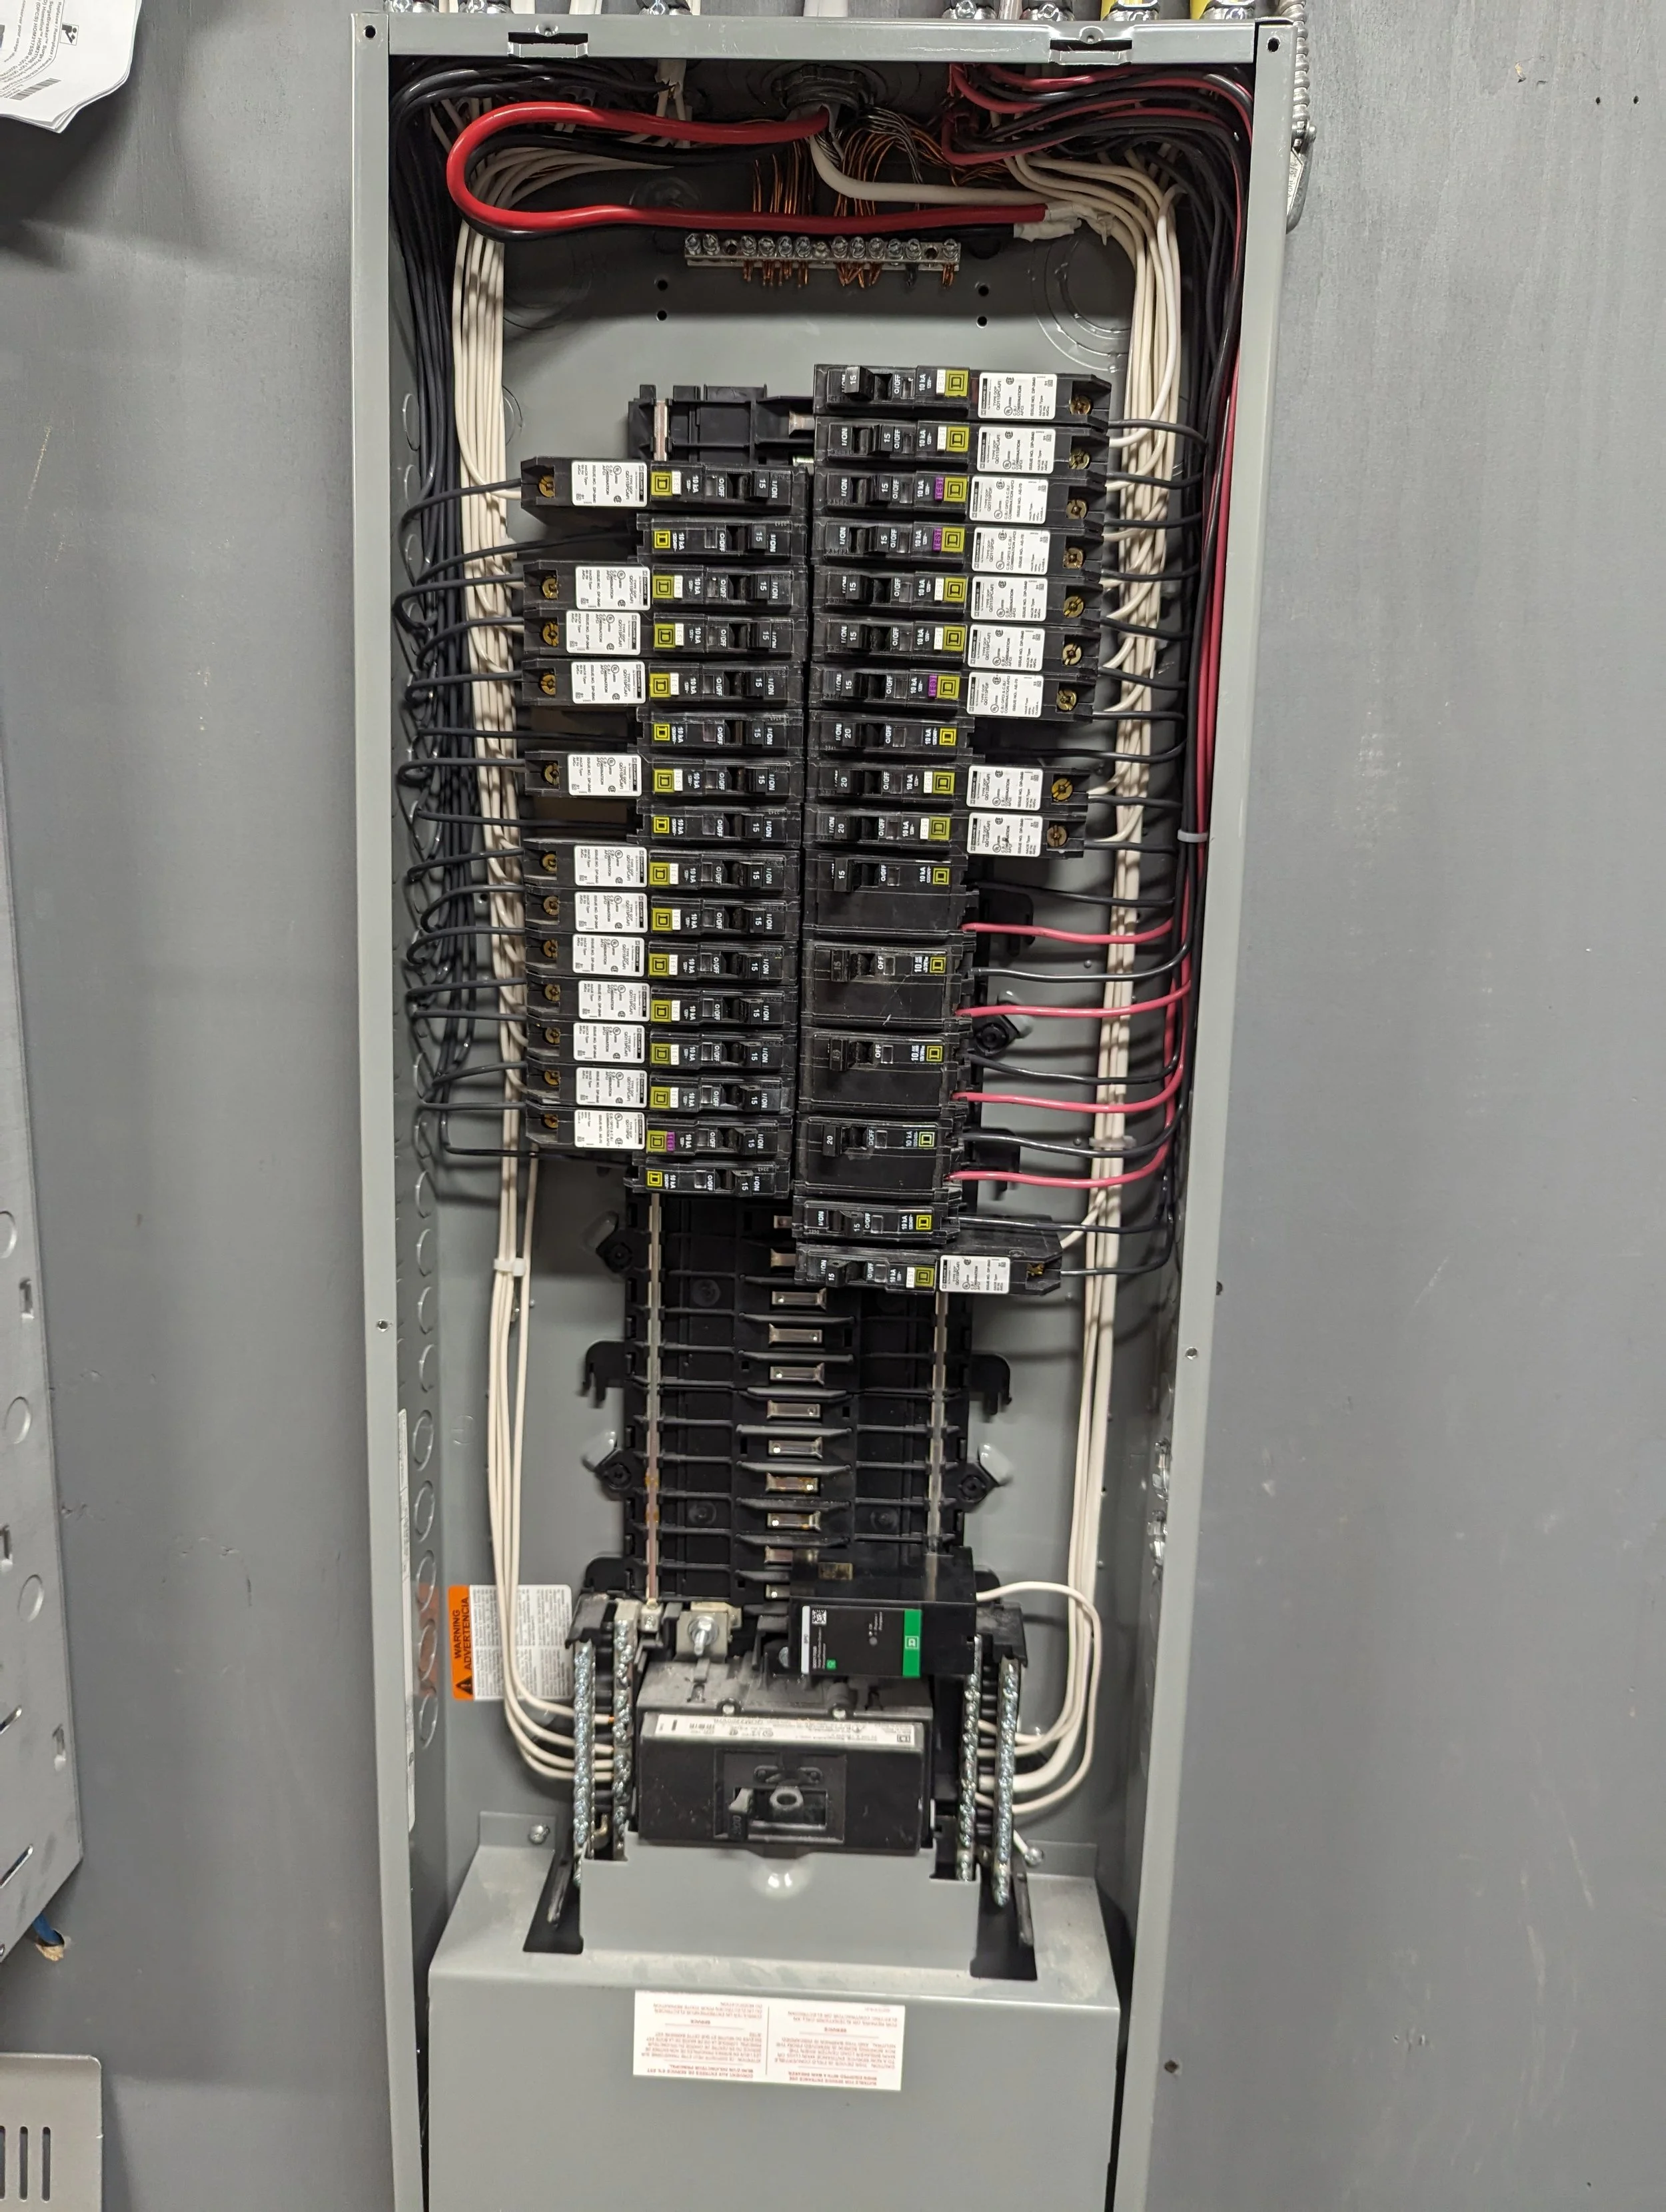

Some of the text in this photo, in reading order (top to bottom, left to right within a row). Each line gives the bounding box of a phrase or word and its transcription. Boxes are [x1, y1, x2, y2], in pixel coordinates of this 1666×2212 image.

[850, 375, 856, 385] 15
[884, 433, 890, 443] 15
[920, 430, 925, 438] kA
[759, 478, 765, 488] 15
[881, 482, 888, 492] 15
[918, 479, 924, 488] kA
[756, 532, 762, 542] 15
[915, 530, 921, 539] kA
[881, 536, 887, 545] 15
[760, 582, 766, 591] 15
[850, 582, 856, 592] 15
[762, 631, 769, 640] 15
[850, 632, 856, 641] 15
[918, 628, 924, 636] kA
[756, 678, 762, 688] 15
[845, 681, 852, 690] 15
[754, 728, 760, 738] 15
[845, 728, 851, 738] 20
[758, 775, 765, 785] 15
[841, 778, 847, 787] 20
[753, 823, 759, 832] 15
[838, 824, 844, 833] 20
[755, 917, 762, 925] 15
[752, 963, 758, 971] 15
[754, 1009, 760, 1017] 15
[751, 1053, 758, 1061] 15
[827, 1135, 832, 1145] 20
[742, 1182, 748, 1191] 15
[854, 1223, 860, 1232] 15
[452, 1610, 461, 1658] WARNING
[461, 1597, 472, 1670] ADVERTENCIA
